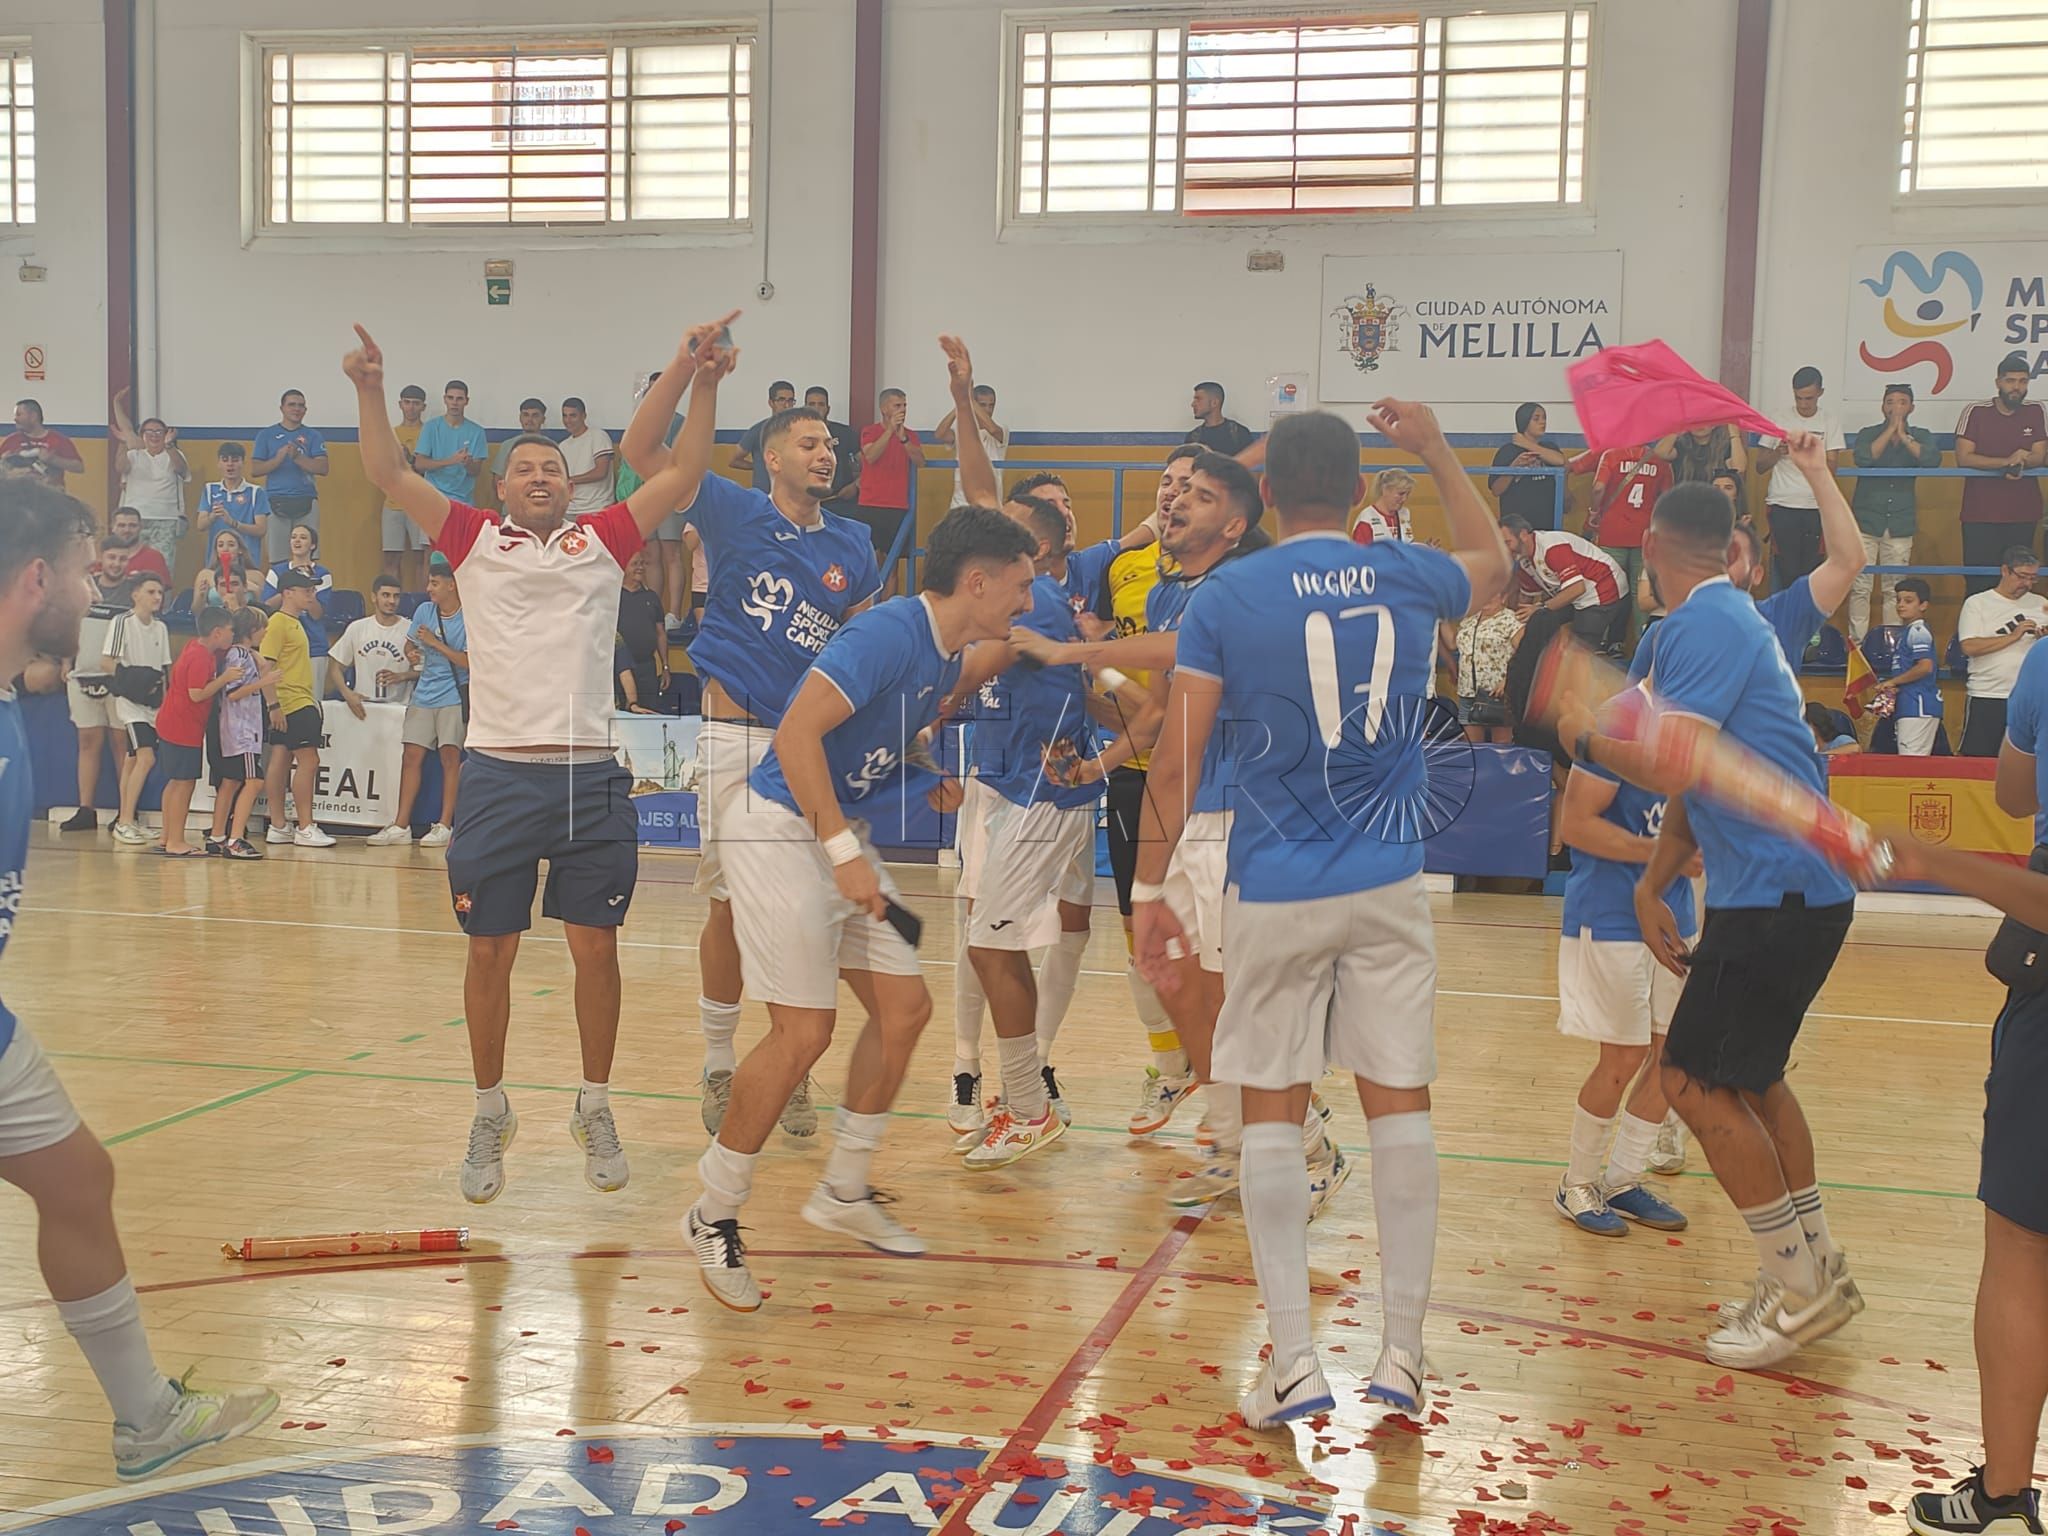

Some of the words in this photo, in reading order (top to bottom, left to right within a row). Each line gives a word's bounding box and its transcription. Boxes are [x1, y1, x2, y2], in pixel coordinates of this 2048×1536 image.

[1415, 301, 1486, 316] CIUDAD
[1492, 297, 1609, 316] AUTÓNOMA
[1419, 322, 1606, 359] MELILLA
[1627, 483, 1644, 508] 4
[1292, 566, 1376, 598] NEGRO
[1305, 604, 1396, 750] 17
[311, 802, 361, 814] eriendas
